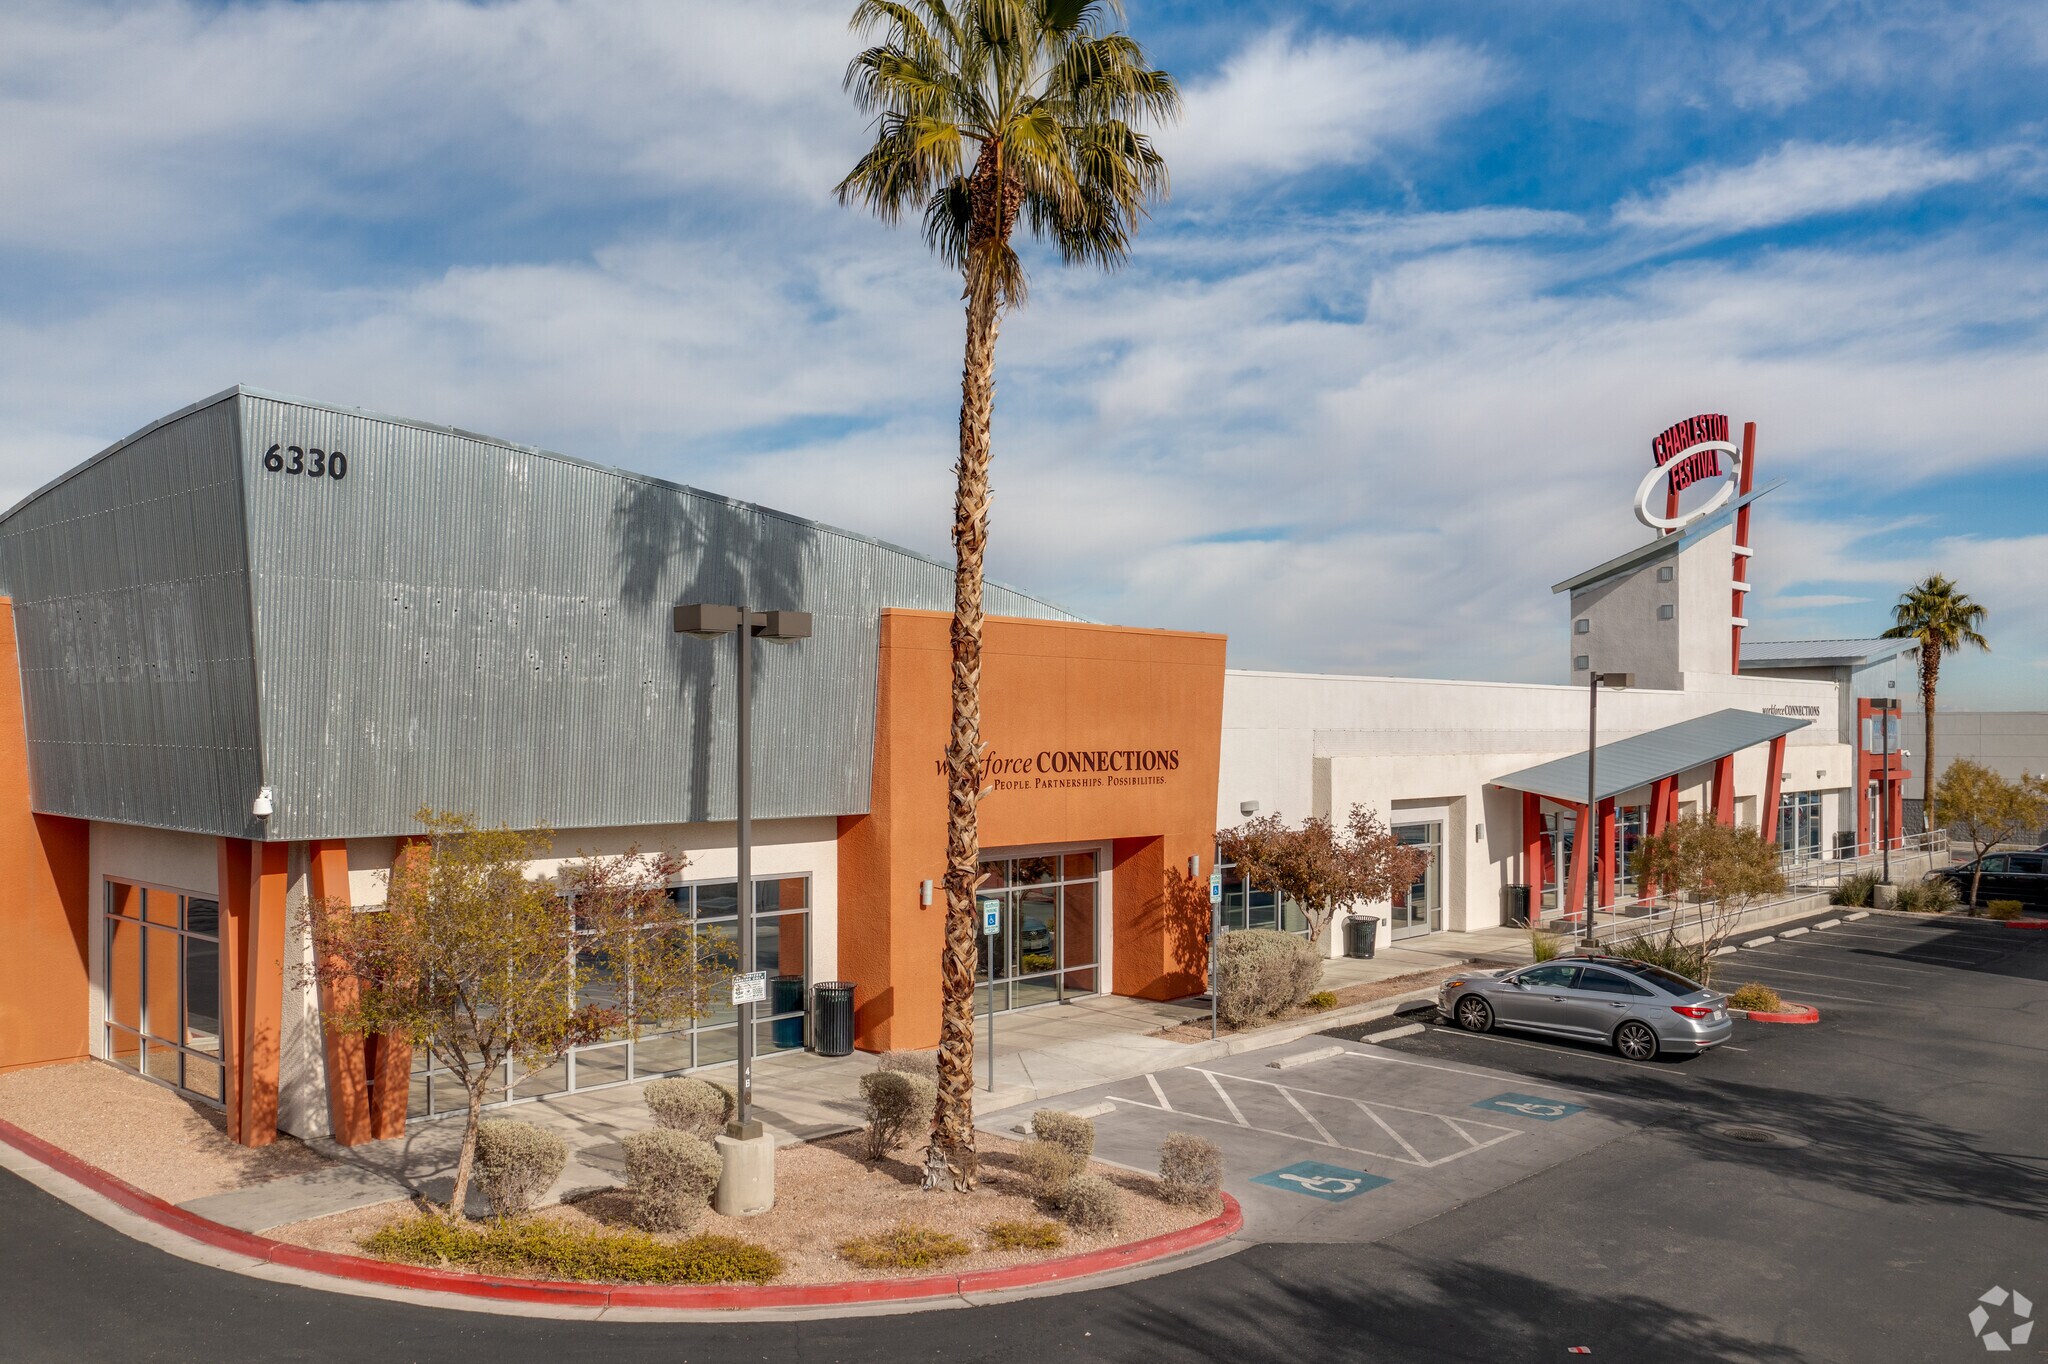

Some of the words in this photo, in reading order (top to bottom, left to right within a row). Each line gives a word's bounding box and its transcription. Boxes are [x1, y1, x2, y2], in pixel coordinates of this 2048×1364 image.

[1652, 413, 1729, 468] CHARLESTON
[264, 443, 347, 481] 6330
[1668, 449, 1722, 496] FESTIVAL
[1036, 749, 1179, 773] CONNECTIONS
